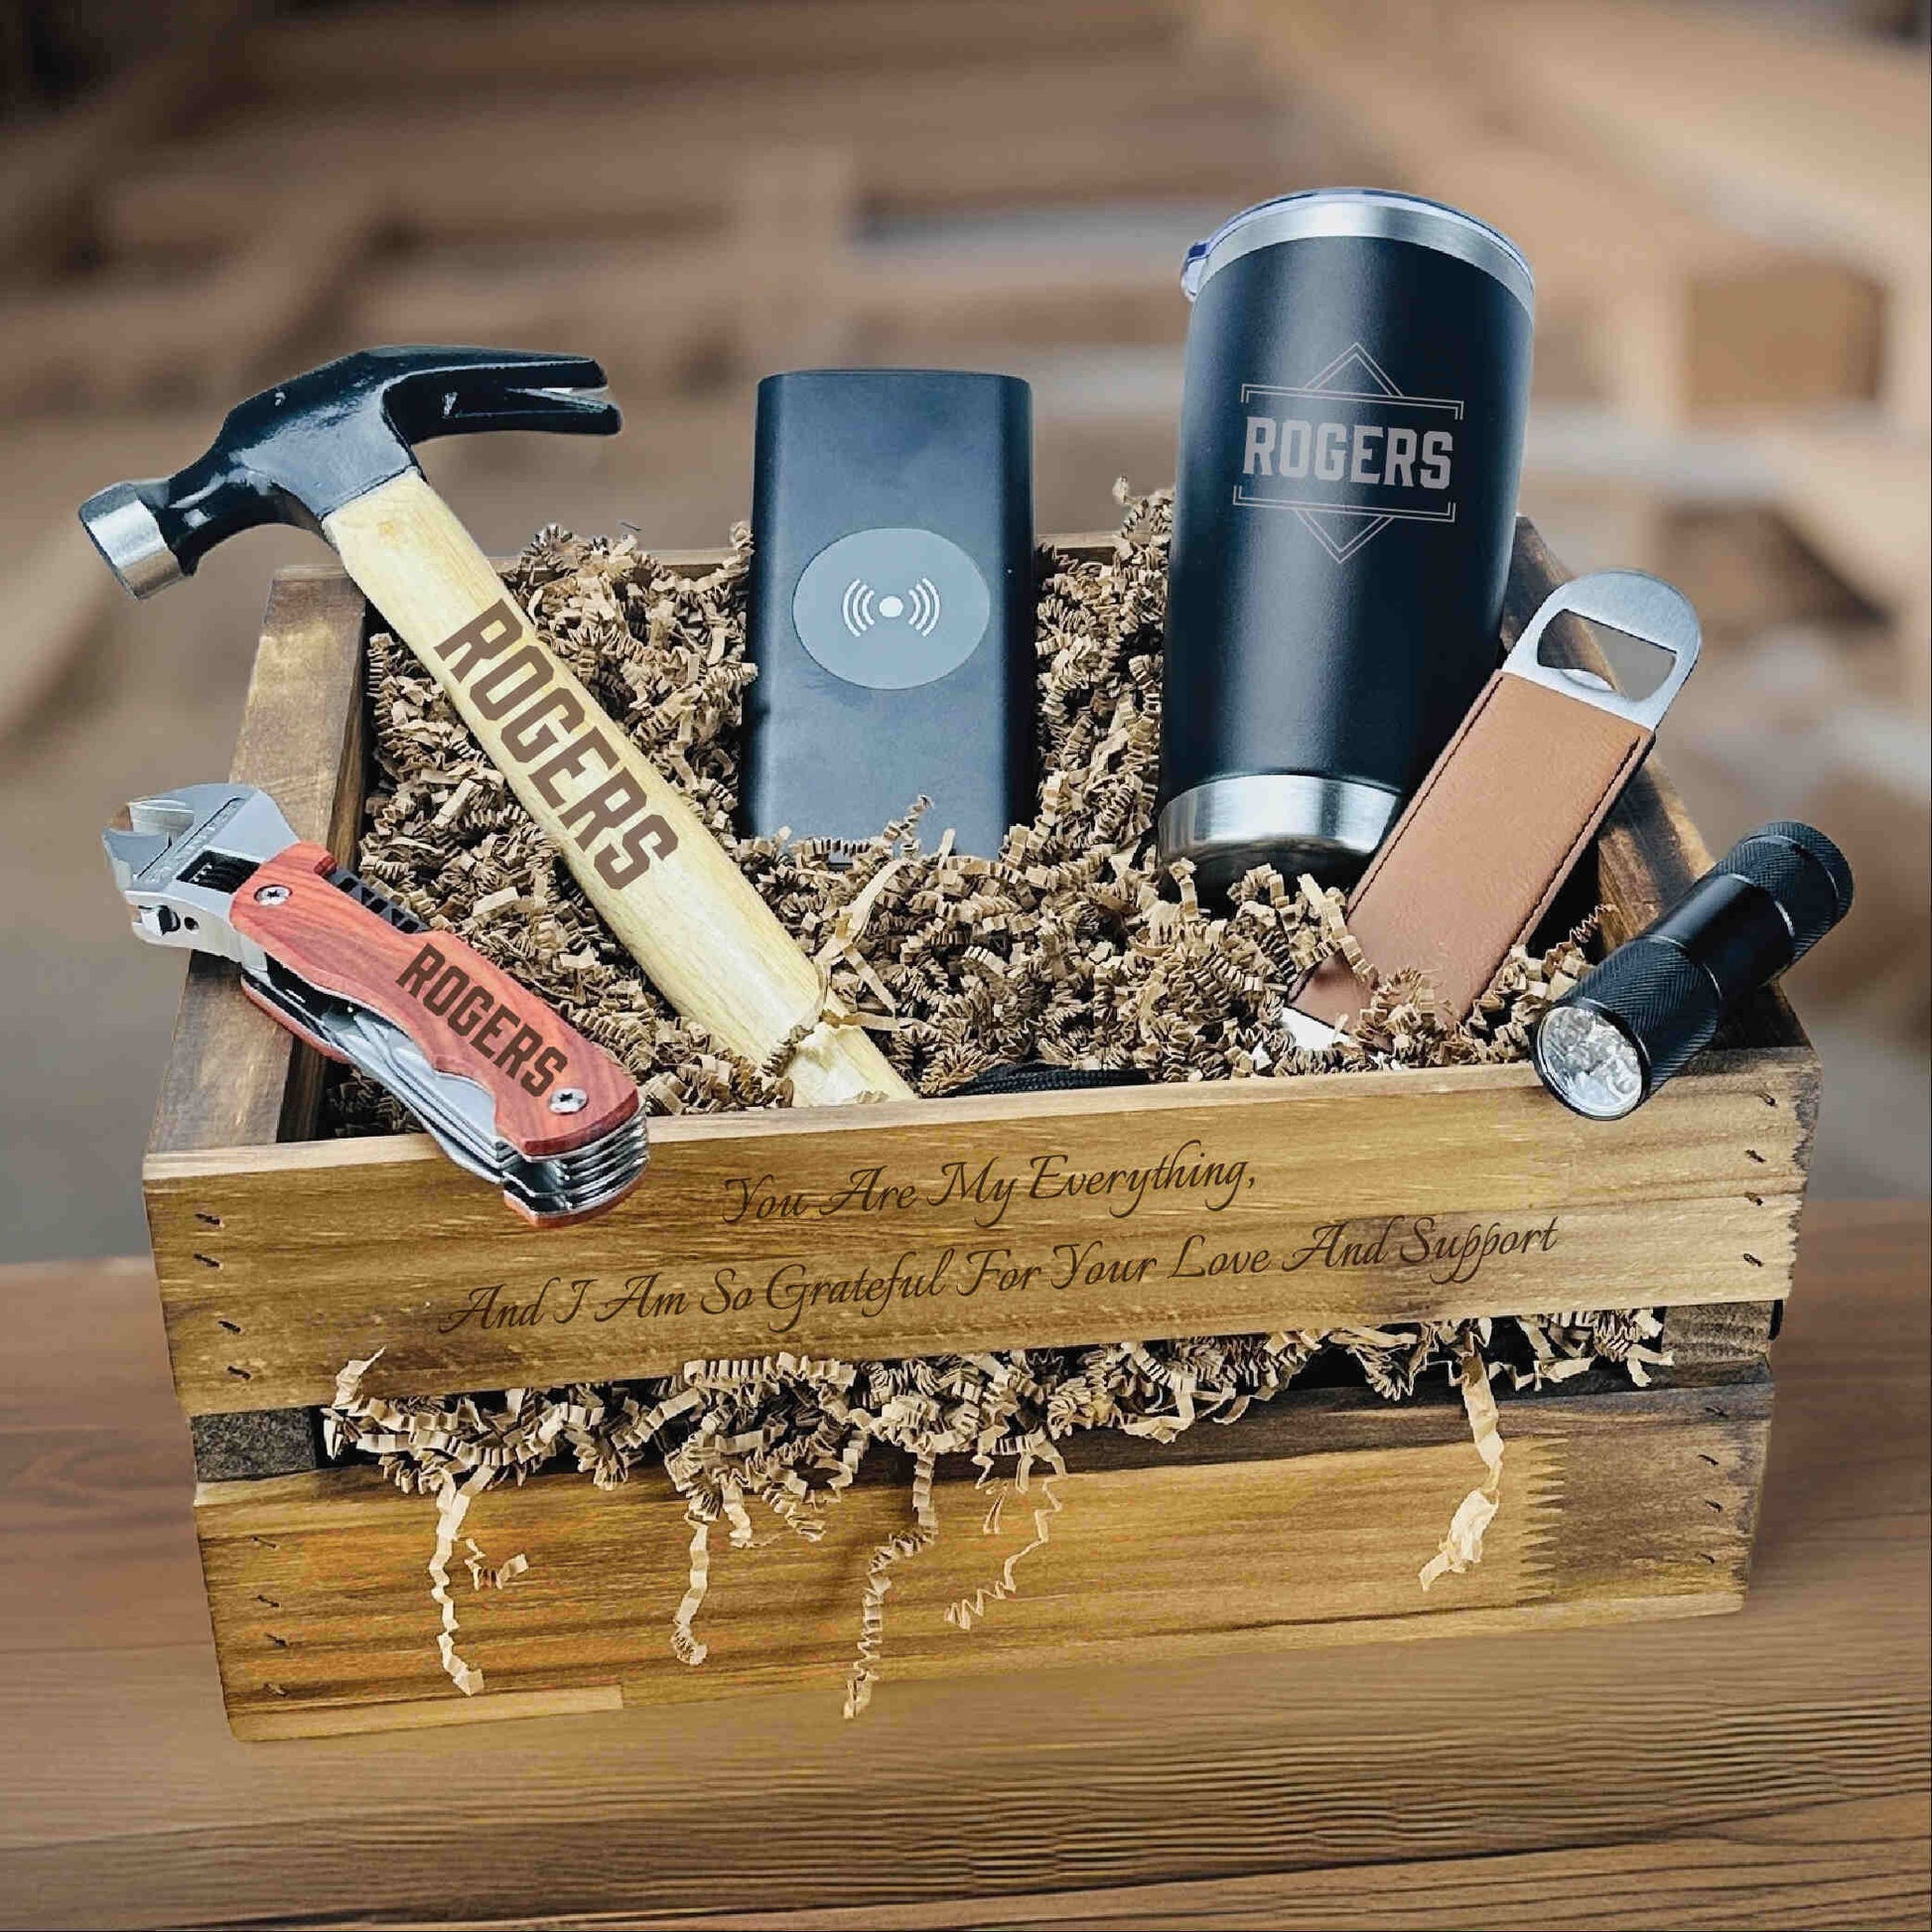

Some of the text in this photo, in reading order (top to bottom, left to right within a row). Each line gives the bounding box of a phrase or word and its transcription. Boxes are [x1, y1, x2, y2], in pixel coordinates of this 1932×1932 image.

[1243, 416, 1453, 489] ROGERS
[434, 599, 679, 890] ROGERS
[396, 943, 569, 1098] ROGERS
[723, 1140, 1255, 1228] You Are My Everything,
[438, 1215, 1560, 1334] And I Am So Grateful For Your Love And Support
